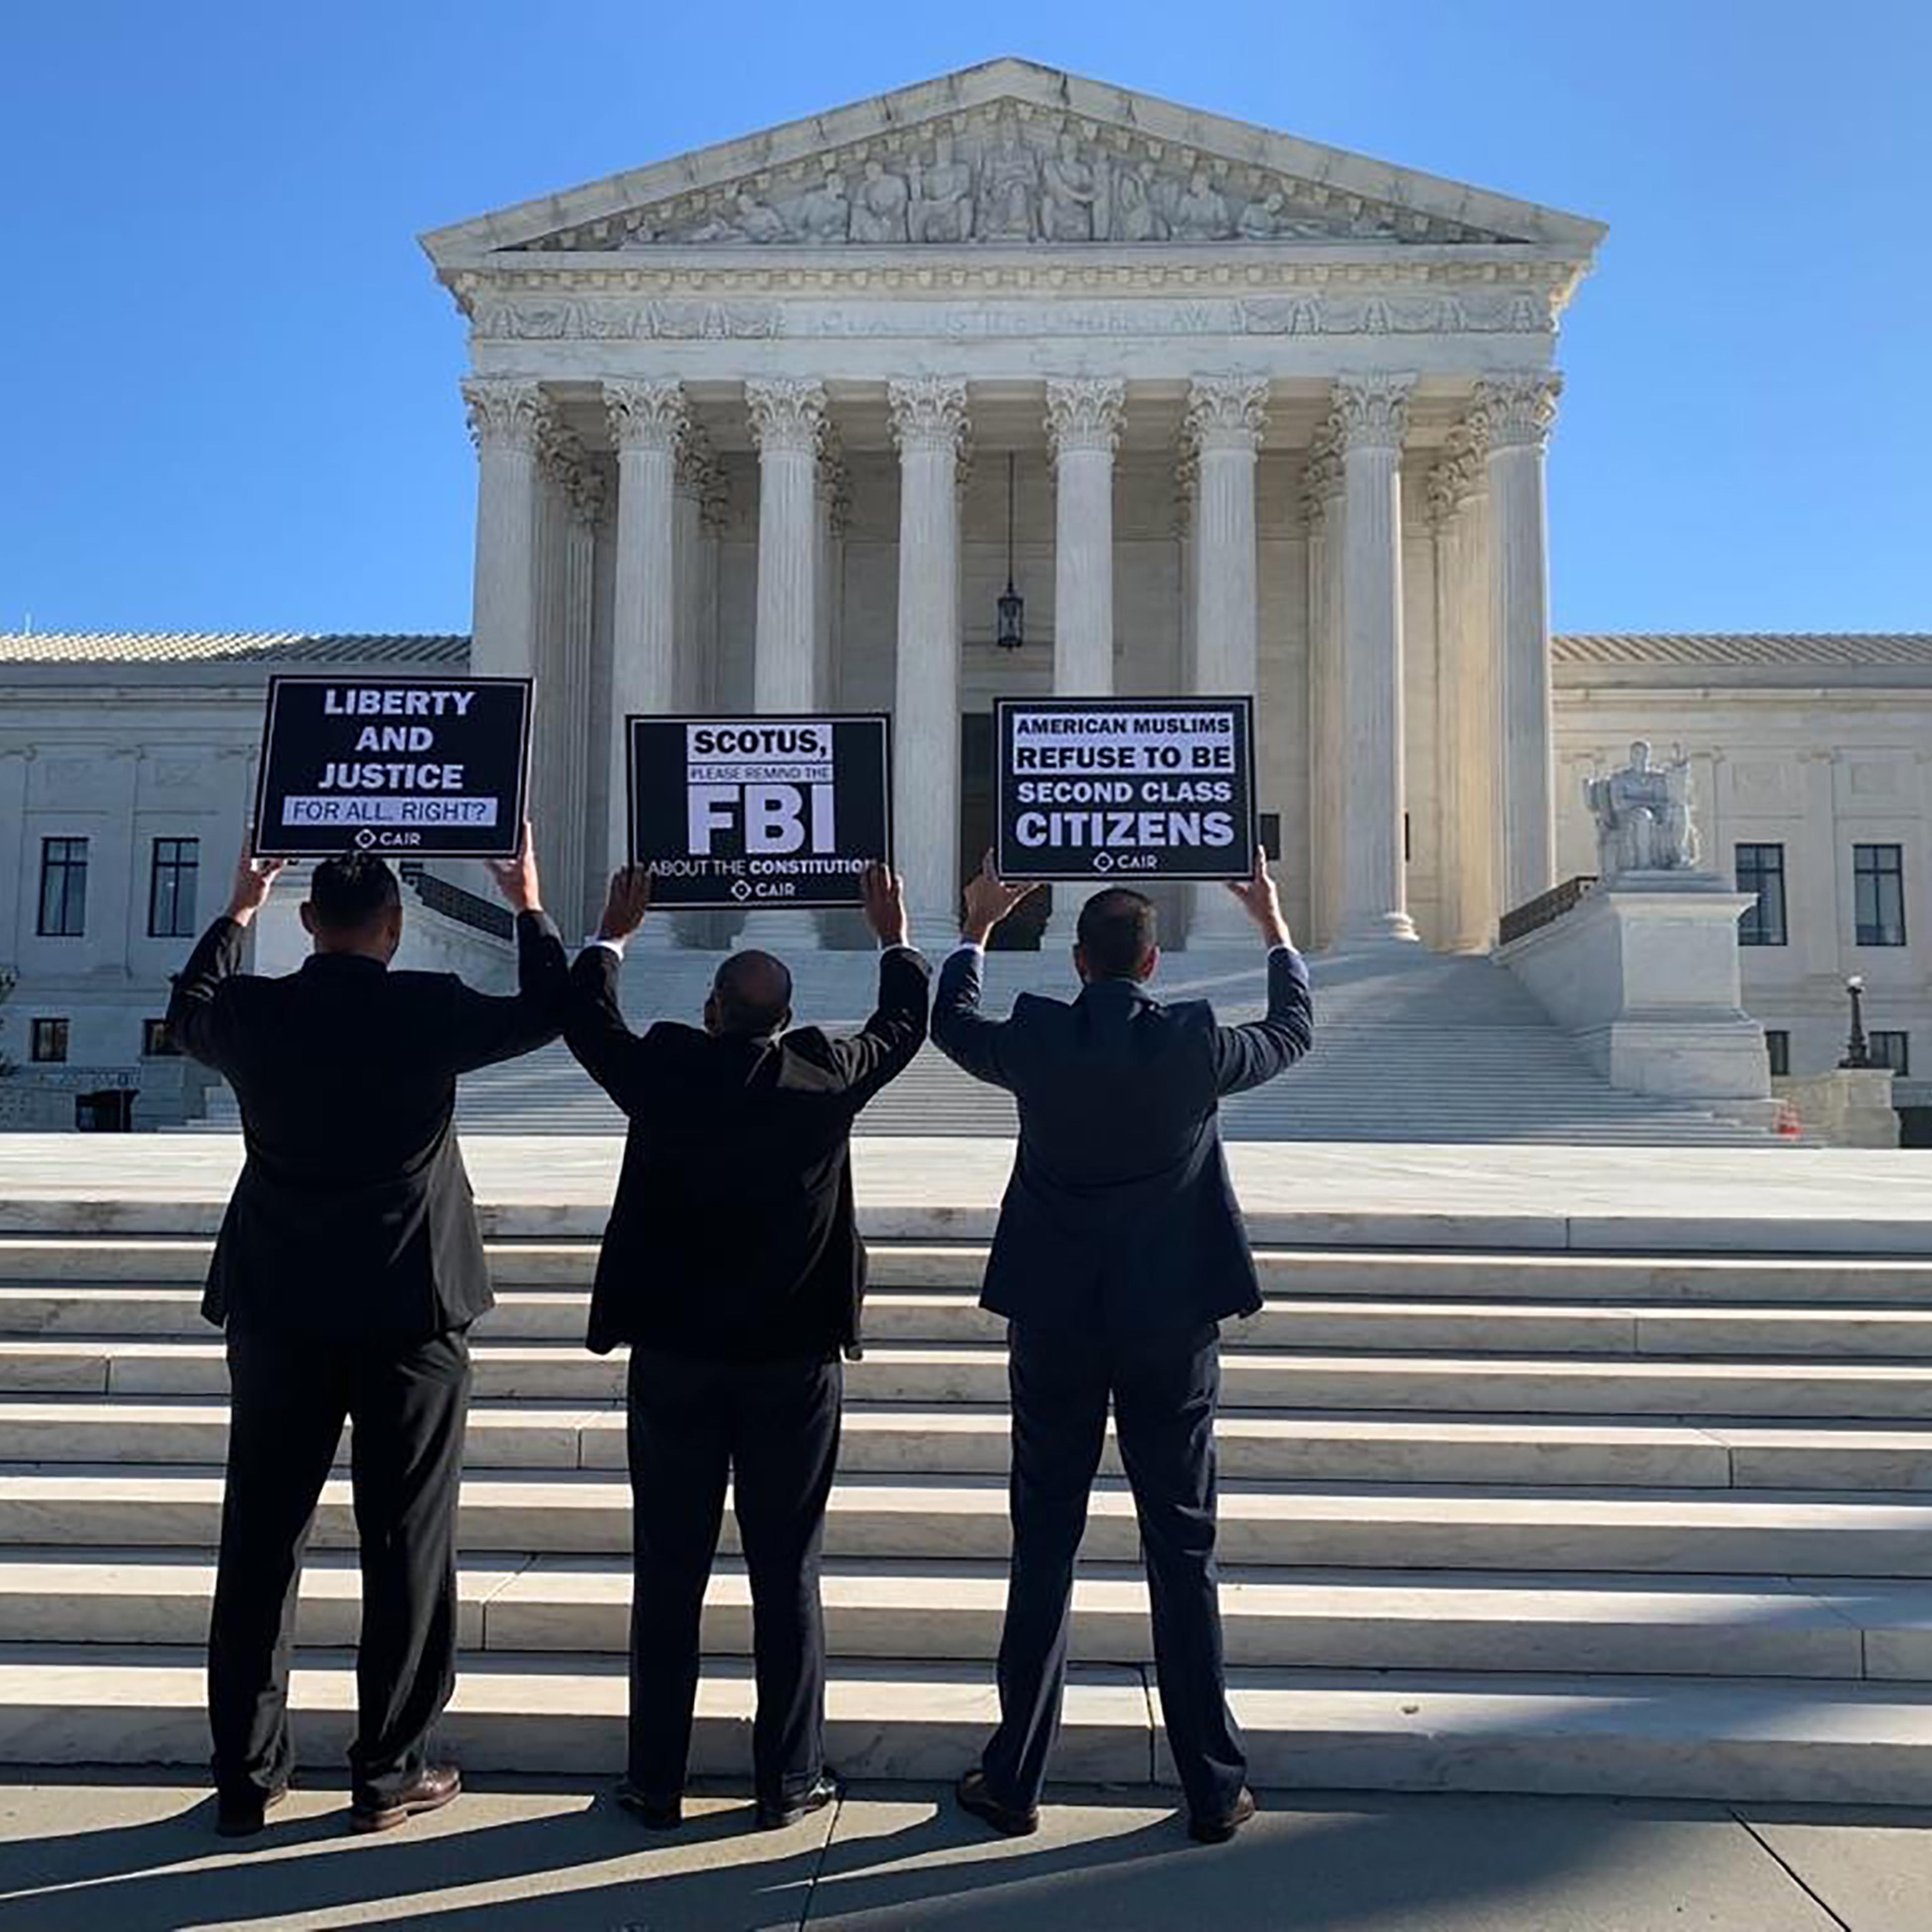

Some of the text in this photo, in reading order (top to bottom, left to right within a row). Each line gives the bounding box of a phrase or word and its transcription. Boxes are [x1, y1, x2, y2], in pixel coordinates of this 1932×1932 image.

[324, 689, 475, 715] LIBERTY
[1017, 718, 1231, 735] AMERICAN MUSLIMS
[355, 726, 434, 751] AND
[694, 729, 826, 756] SCOTUS,
[1016, 747, 1231, 768] REFUSE TO BE
[318, 763, 464, 789] JUSTICE
[691, 767, 742, 780] PLEASE
[805, 767, 829, 778] THE
[1018, 781, 1232, 802] SECOND CLASS
[293, 802, 340, 820] FOR
[402, 802, 487, 821] RIGHT?
[688, 784, 835, 854] FBI
[379, 832, 422, 846] CAIR
[1016, 812, 1235, 846] CITIZENS
[646, 859, 707, 876] ABOUT
[714, 859, 746, 876] THE
[1117, 856, 1158, 869] CAIR
[755, 882, 795, 897] CAIR
